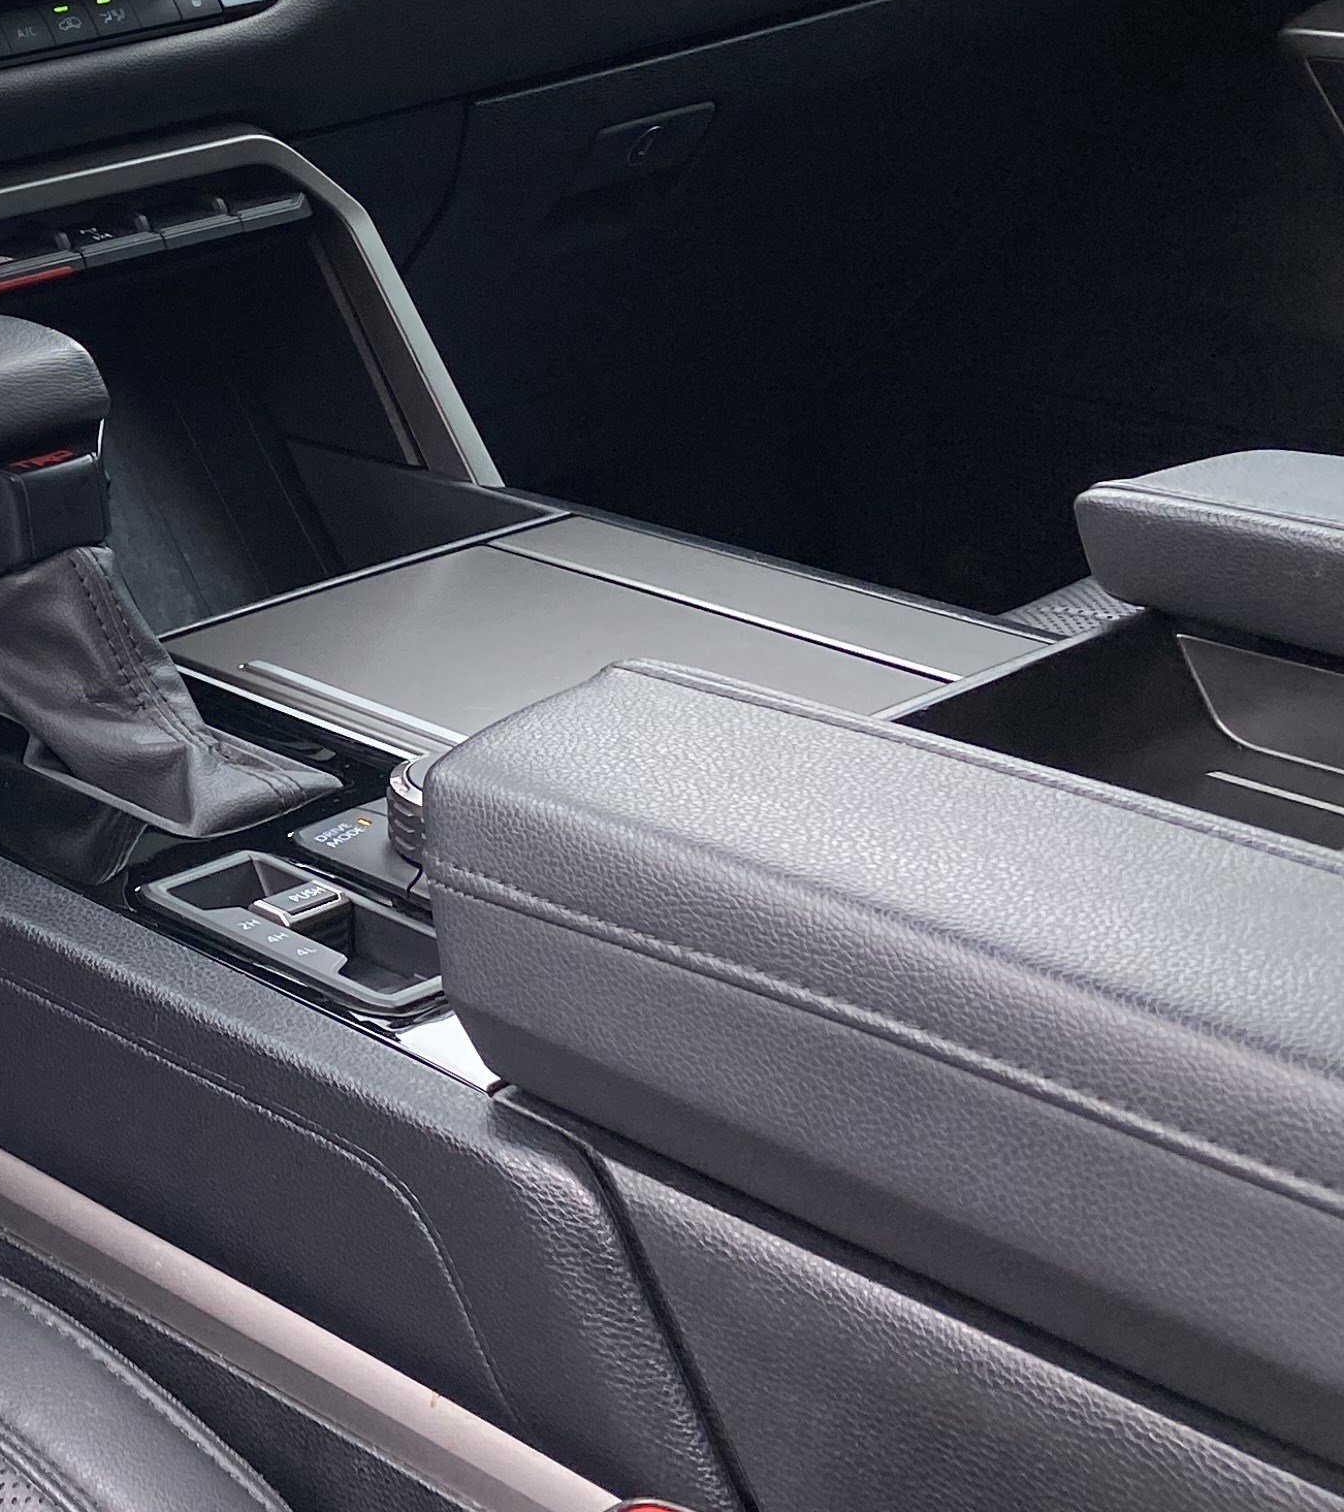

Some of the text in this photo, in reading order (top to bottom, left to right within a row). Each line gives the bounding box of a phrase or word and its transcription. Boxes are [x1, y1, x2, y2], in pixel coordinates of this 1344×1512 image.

[16, 25, 37, 40] A/C
[314, 822, 354, 844] DRIVE
[325, 826, 367, 849] MODE
[288, 885, 327, 904] PUSH
[237, 918, 261, 931] 2H
[267, 931, 290, 944] 4H
[295, 946, 317, 958] 4L
